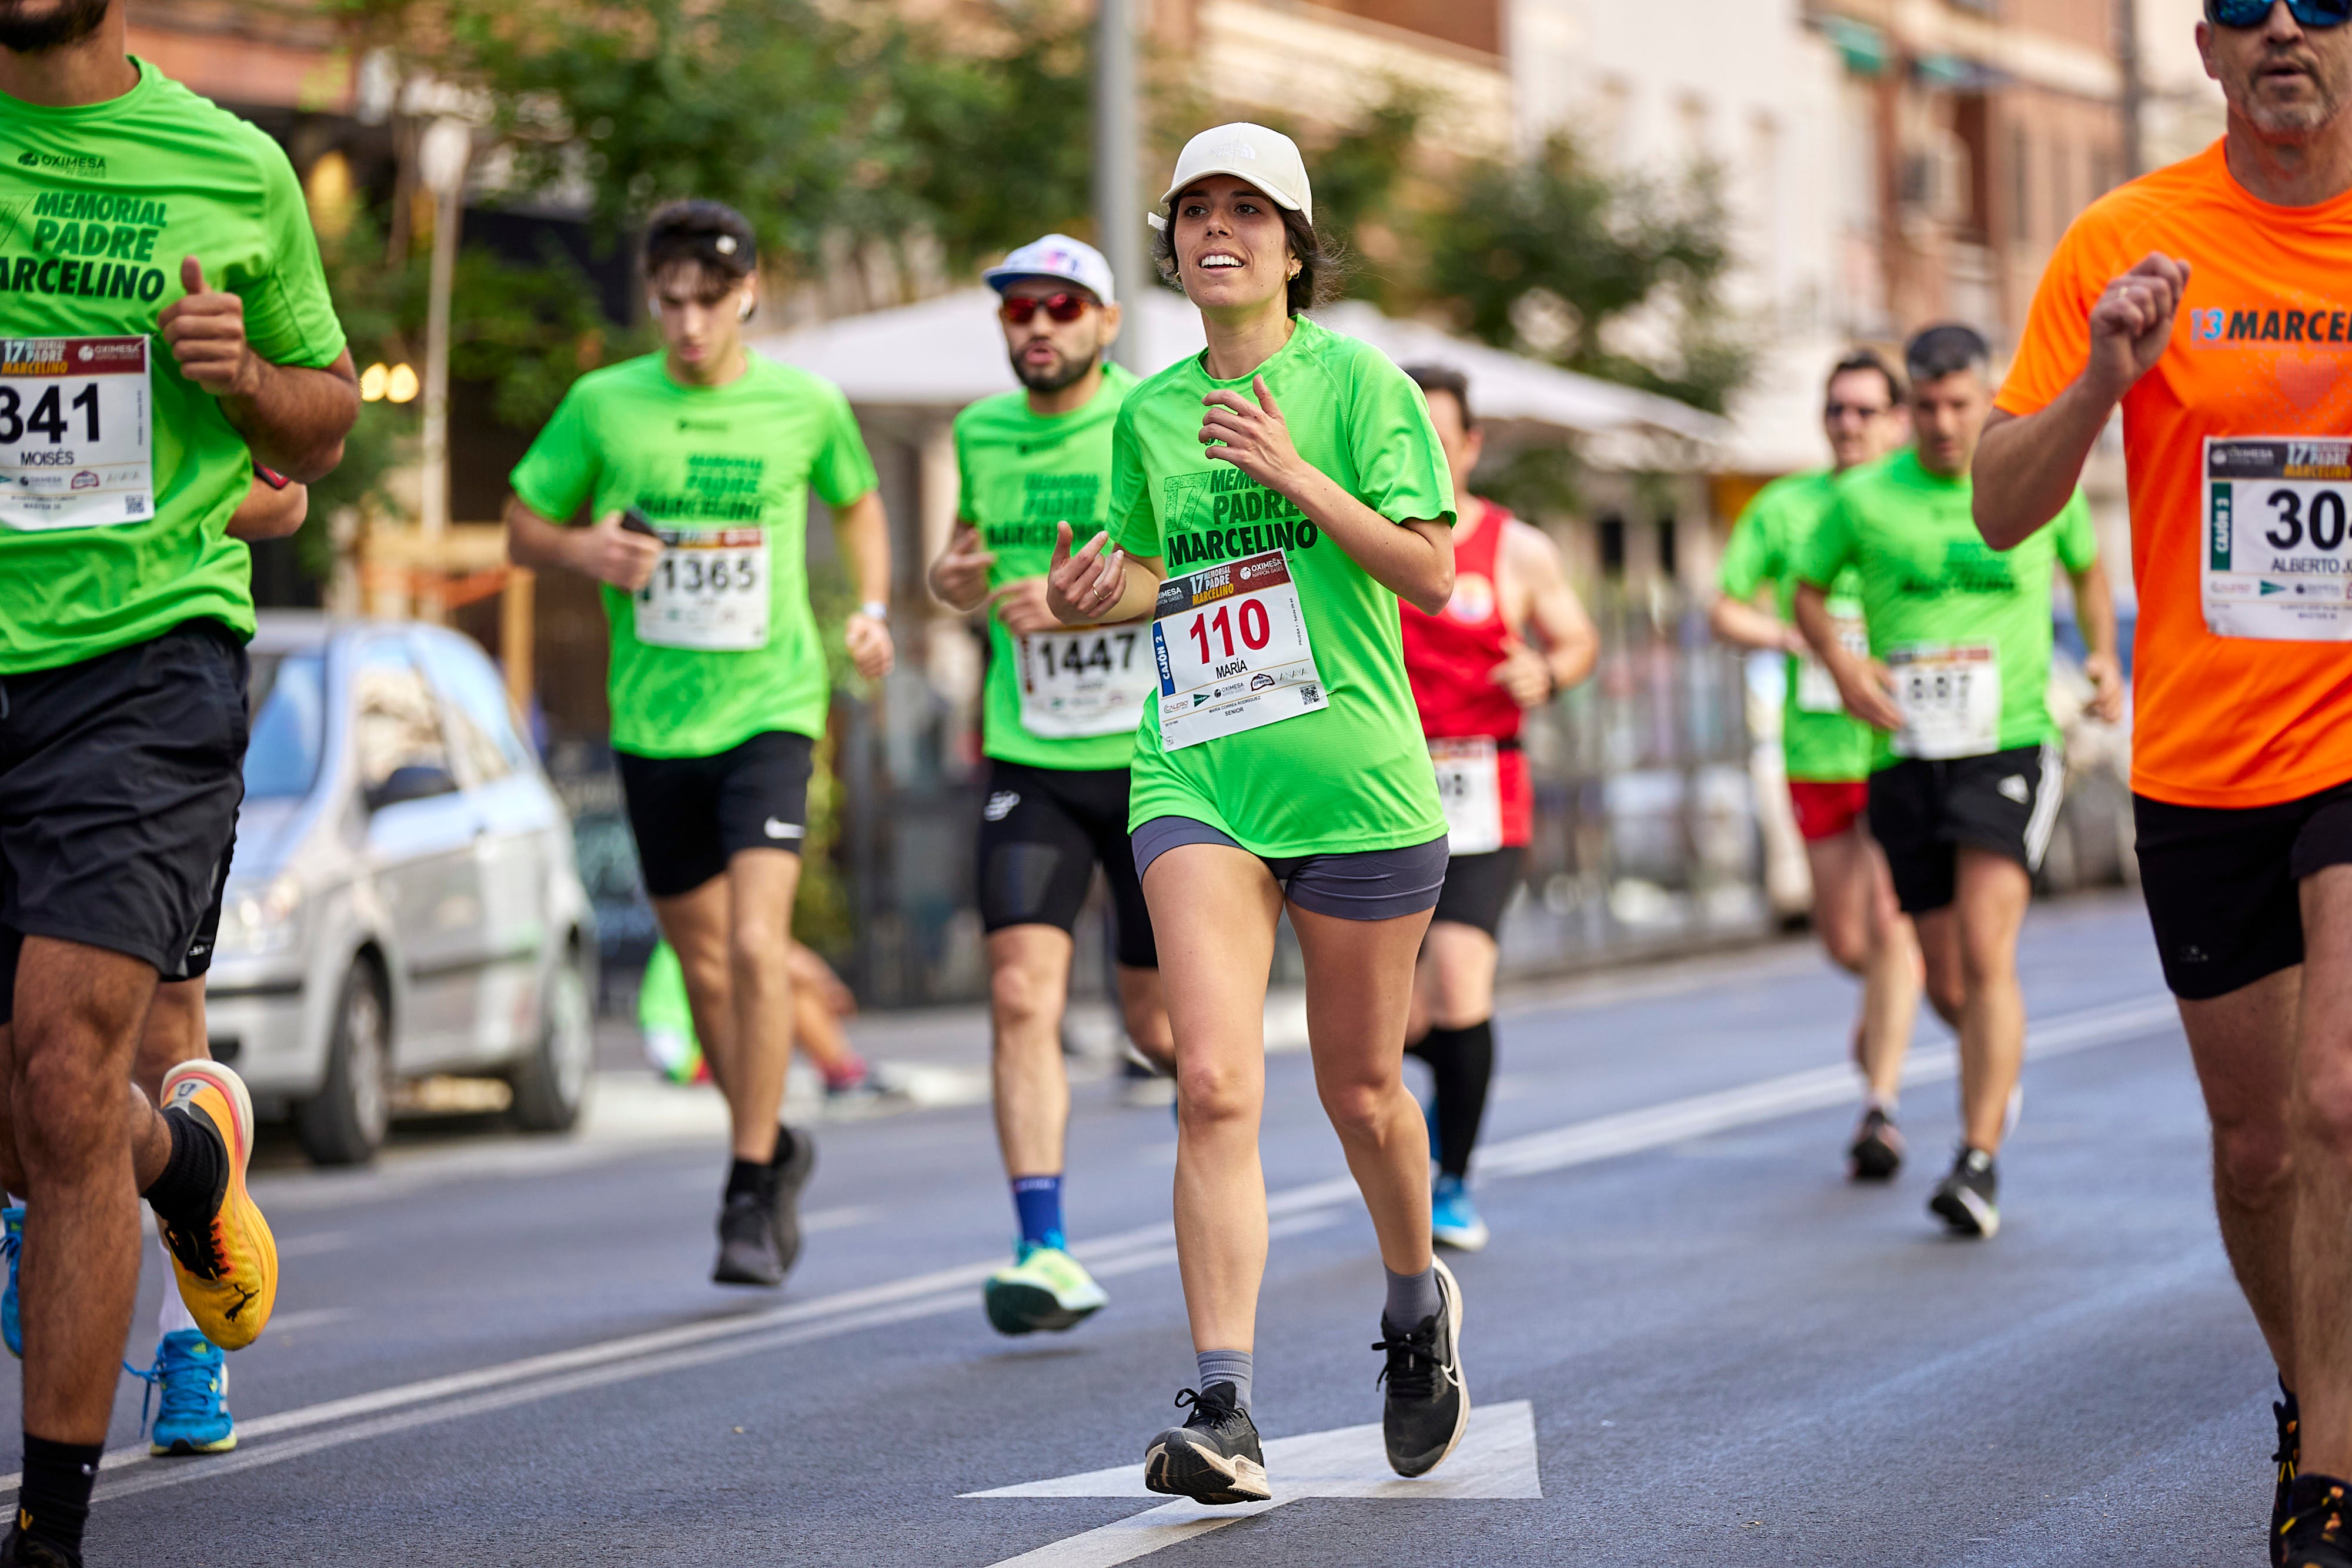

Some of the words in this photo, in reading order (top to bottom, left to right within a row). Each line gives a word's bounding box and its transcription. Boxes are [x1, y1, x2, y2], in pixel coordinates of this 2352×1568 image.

[41, 155, 106, 169] OXIMESA
[32, 192, 167, 228] MEMORIAL
[32, 219, 159, 262] PADRE
[2191, 307, 2224, 341] 13
[2227, 310, 2352, 342] MARCE
[4, 340, 25, 362] 17
[25, 350, 64, 362] PADRE
[94, 344, 139, 353] OXIMESA
[1, 360, 69, 374] MARCELINO
[21, 448, 74, 466] MOISÉS
[2287, 442, 2308, 464] 17
[1164, 472, 1211, 533] 17
[1213, 489, 1300, 524] PADRE
[2266, 489, 2352, 551] 30
[1168, 519, 1318, 567] MARCELINO
[662, 558, 757, 593] 1365
[1204, 566, 1231, 580] MEMORIAL
[1251, 559, 1282, 571] OXIMESA
[1252, 570, 1270, 578] NIPPON
[2271, 557, 2340, 573] ALBERTO
[1190, 574, 1204, 594] 17
[1205, 574, 1230, 591] PADRE
[1192, 583, 1234, 606] MARCELINO
[1190, 599, 1270, 664] 110
[1040, 633, 1137, 678] 1447
[1157, 646, 1170, 680] CAJÓN
[1215, 657, 1248, 679] MARÍA
[1221, 682, 1244, 693] OXIMESA
[1165, 700, 1189, 712] CALERO
[1225, 707, 1244, 716] SENIOR
